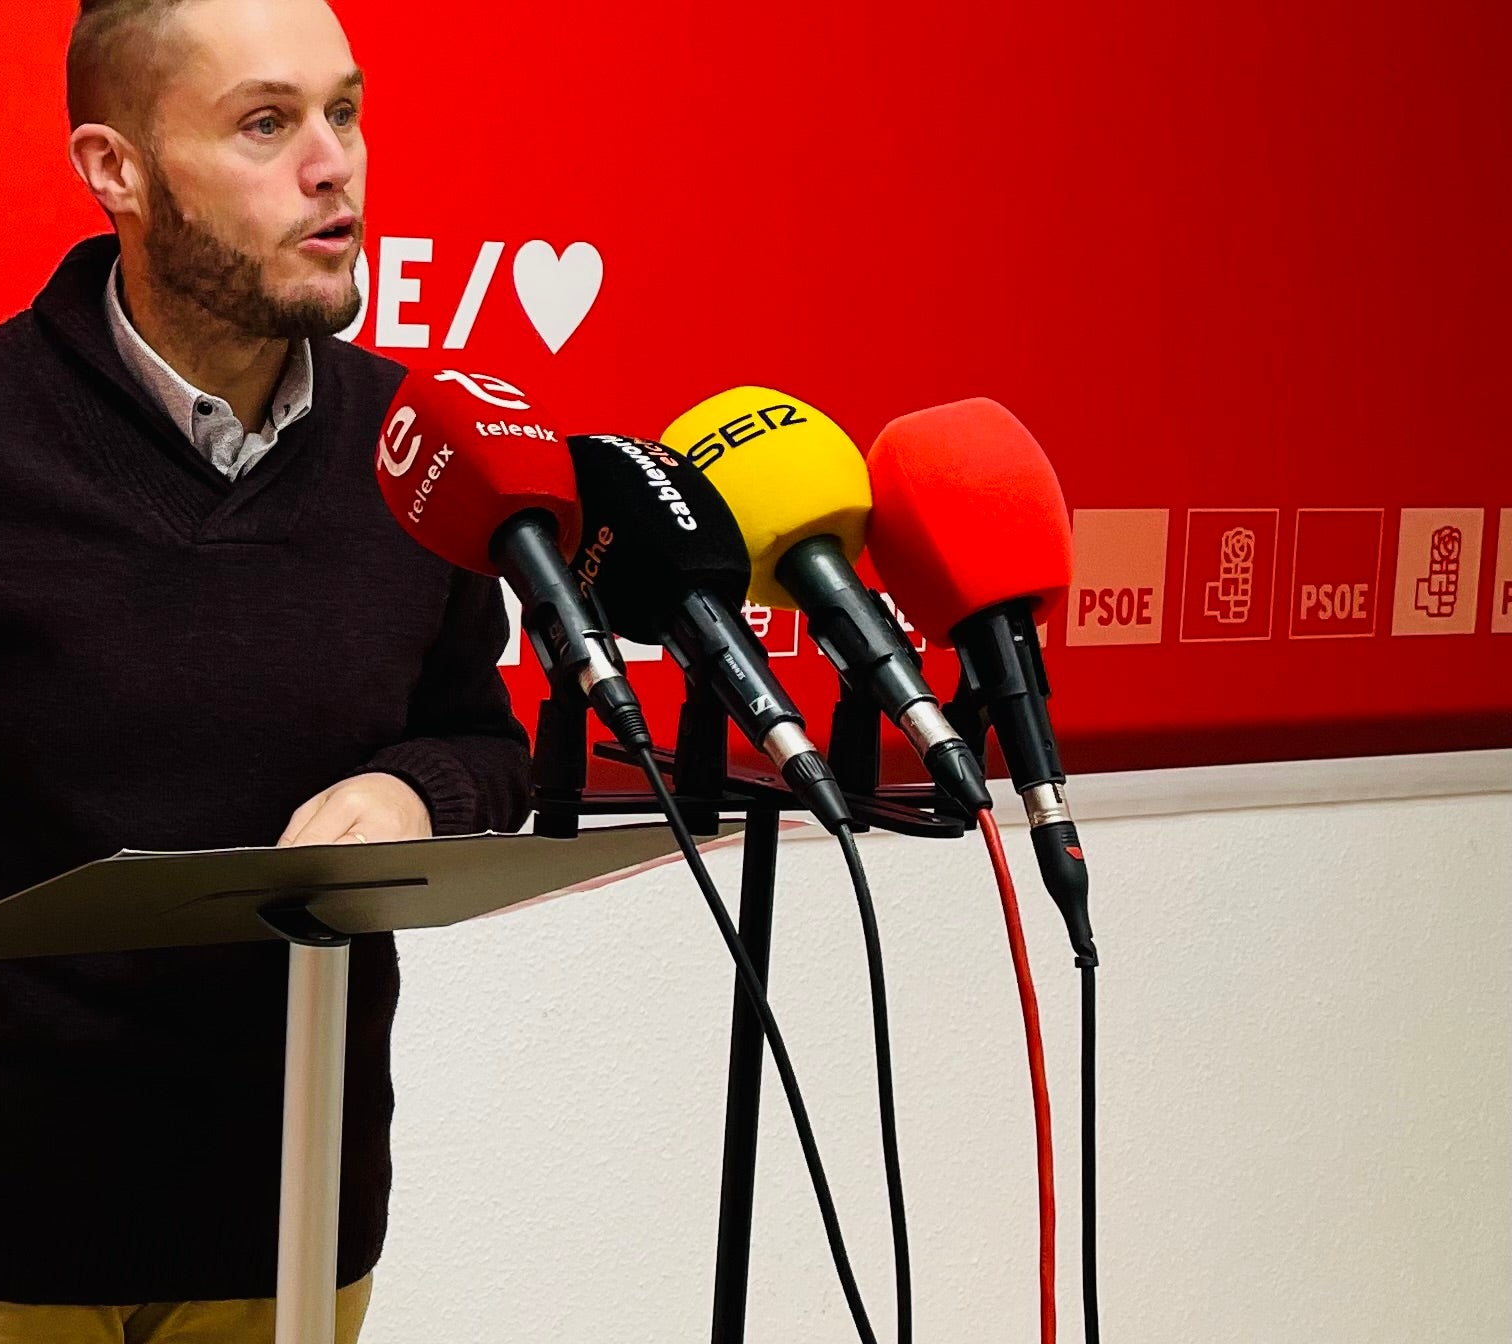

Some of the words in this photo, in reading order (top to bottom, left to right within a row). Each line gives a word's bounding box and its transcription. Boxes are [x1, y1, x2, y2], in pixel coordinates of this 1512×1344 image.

[476, 420, 559, 443] teleelx
[686, 404, 808, 472] SER
[407, 443, 455, 523] teleelx
[1078, 587, 1154, 627] PSOE
[1300, 583, 1369, 620] PSOE
